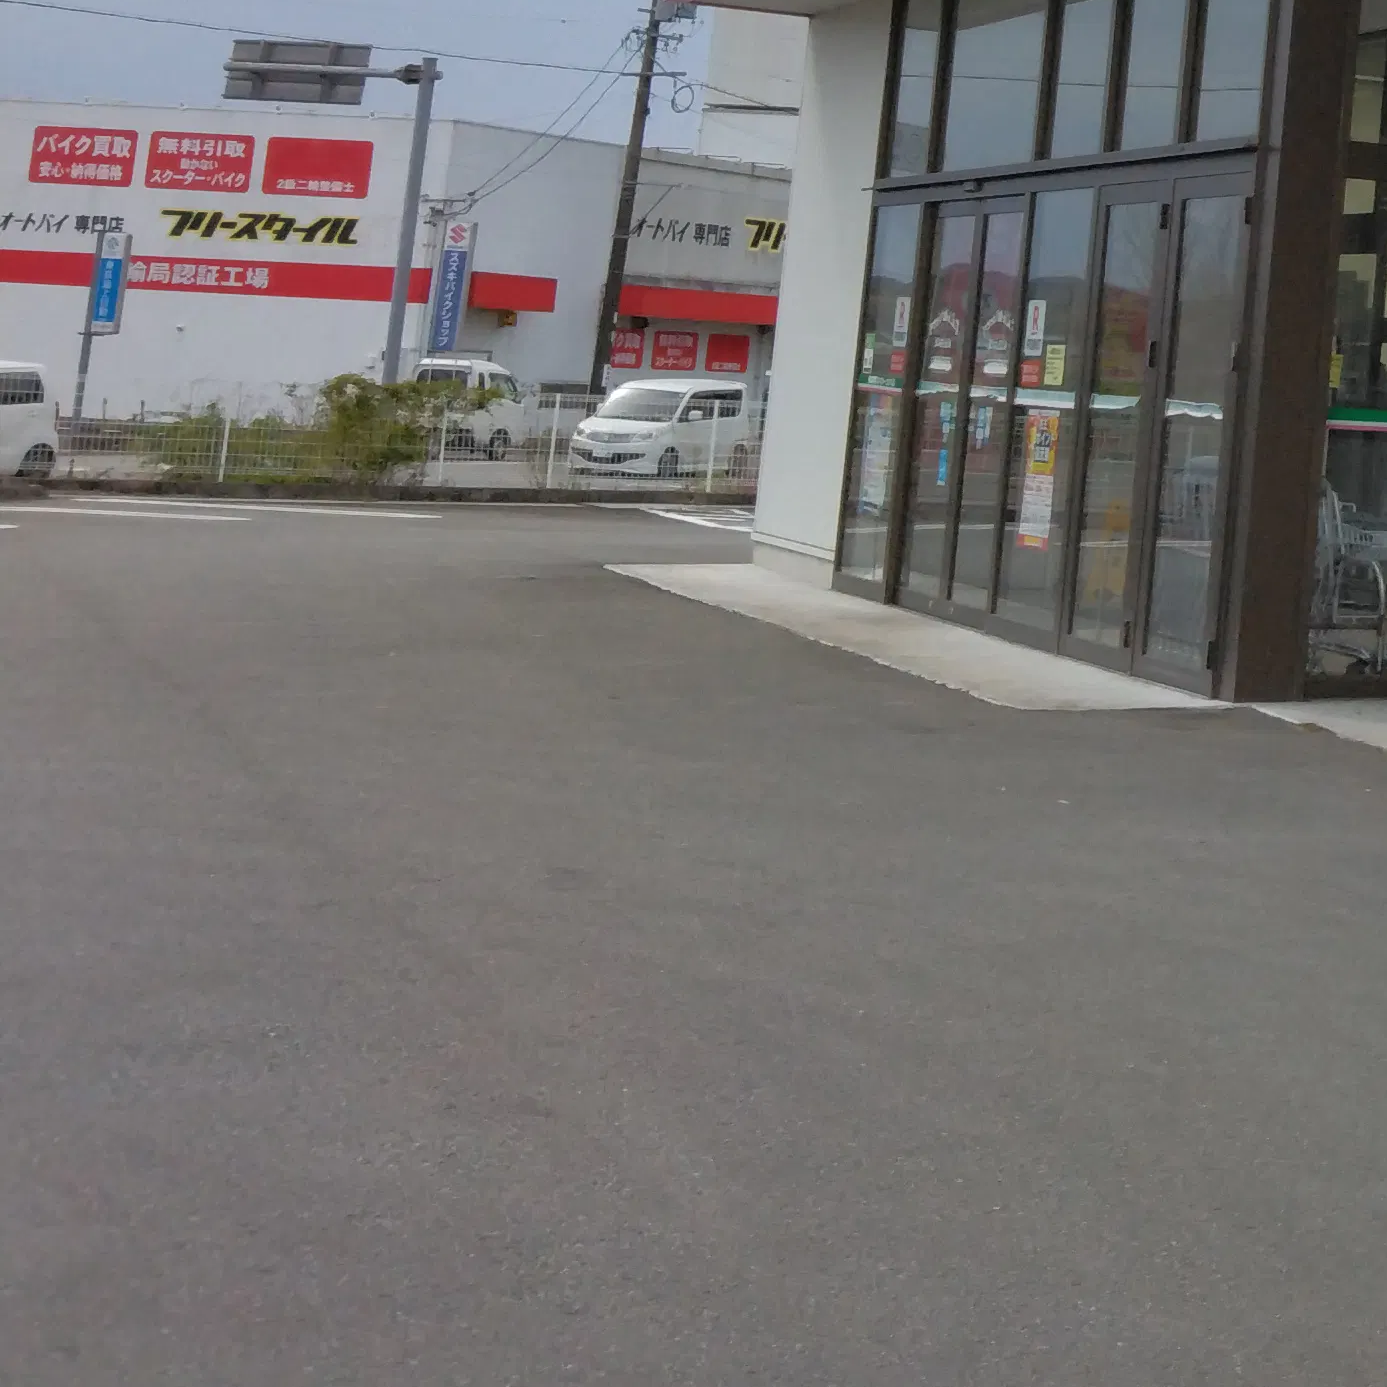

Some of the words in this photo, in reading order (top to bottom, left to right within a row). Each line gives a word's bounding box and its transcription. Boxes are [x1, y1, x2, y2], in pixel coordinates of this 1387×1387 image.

[36, 133, 132, 158] バイク買取
[157, 136, 246, 158] 無料引取
[150, 169, 246, 188] スクーター・バイク
[74, 214, 125, 234] 専門店
[160, 209, 360, 246] フリースタイル
[631, 217, 691, 243] オートバイ
[693, 222, 732, 247] 専門店
[744, 217, 787, 254] フリ
